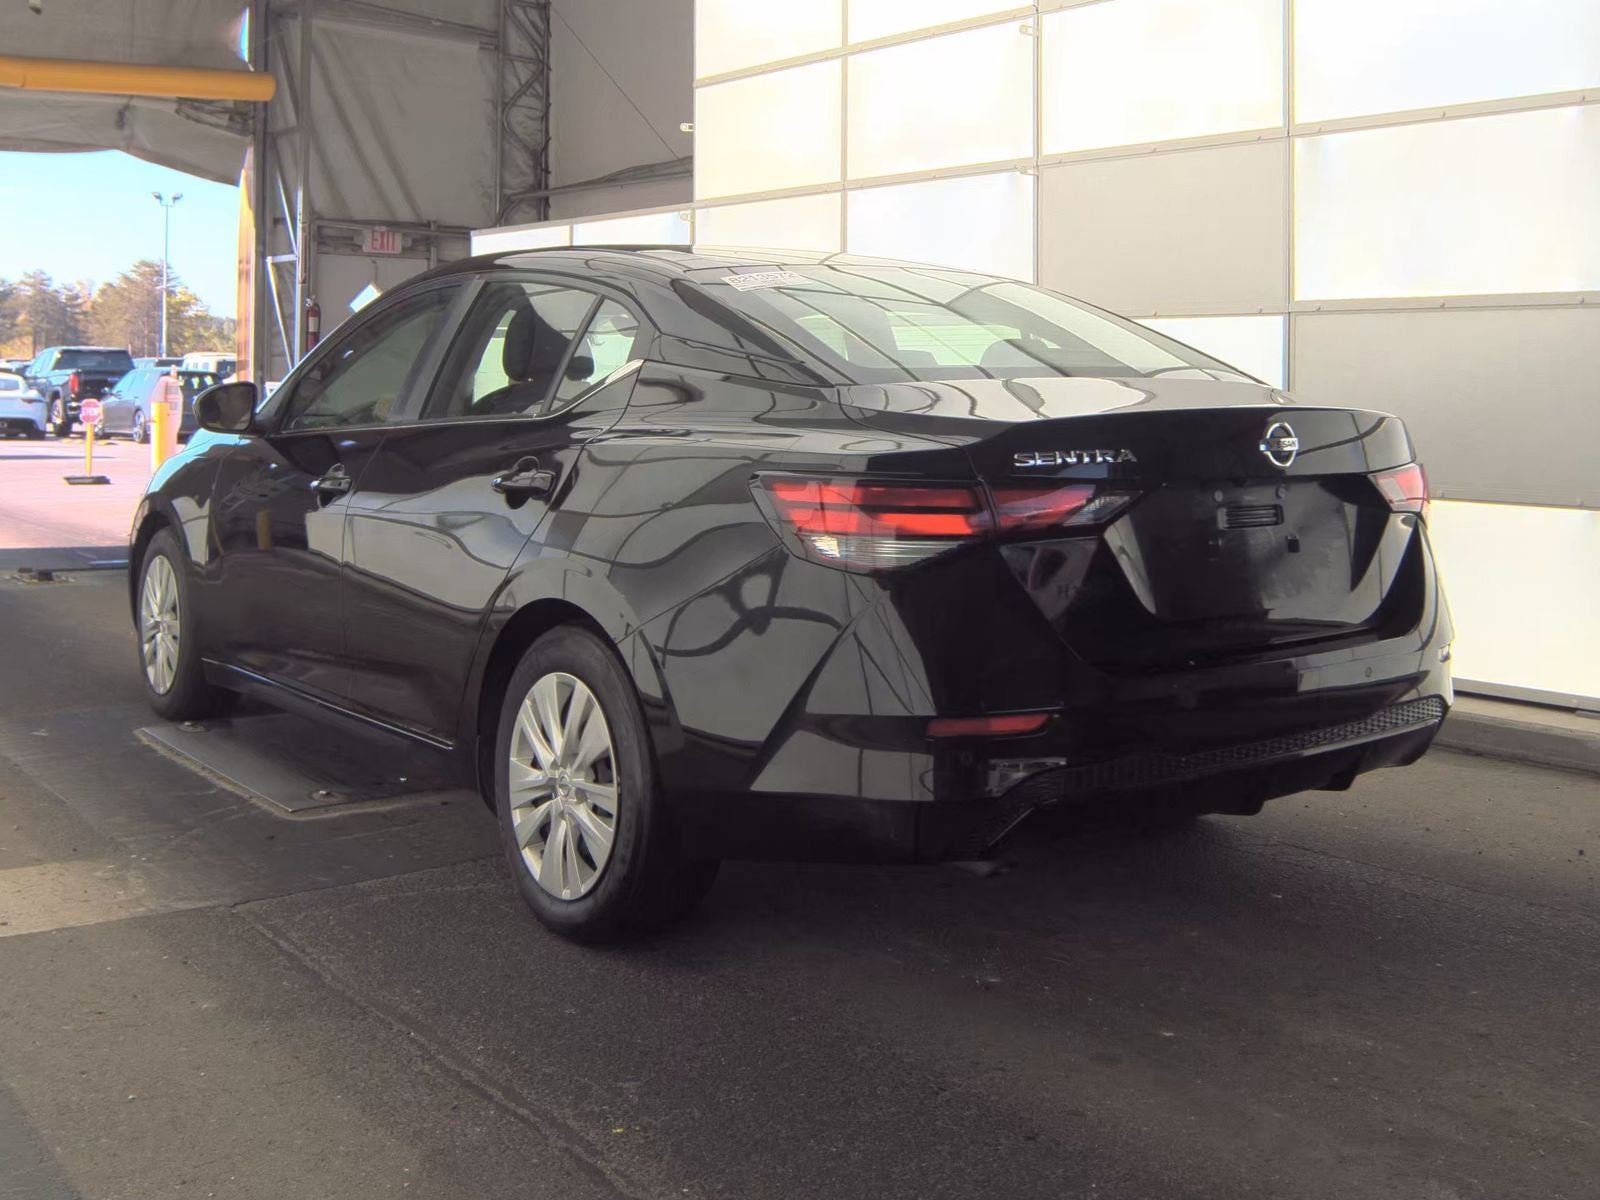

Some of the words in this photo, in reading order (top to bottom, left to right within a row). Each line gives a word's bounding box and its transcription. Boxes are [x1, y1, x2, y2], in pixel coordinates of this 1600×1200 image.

[371, 230, 396, 251] EXIT
[81, 407, 101, 416] STOP
[1014, 449, 1137, 466] SENTRA
